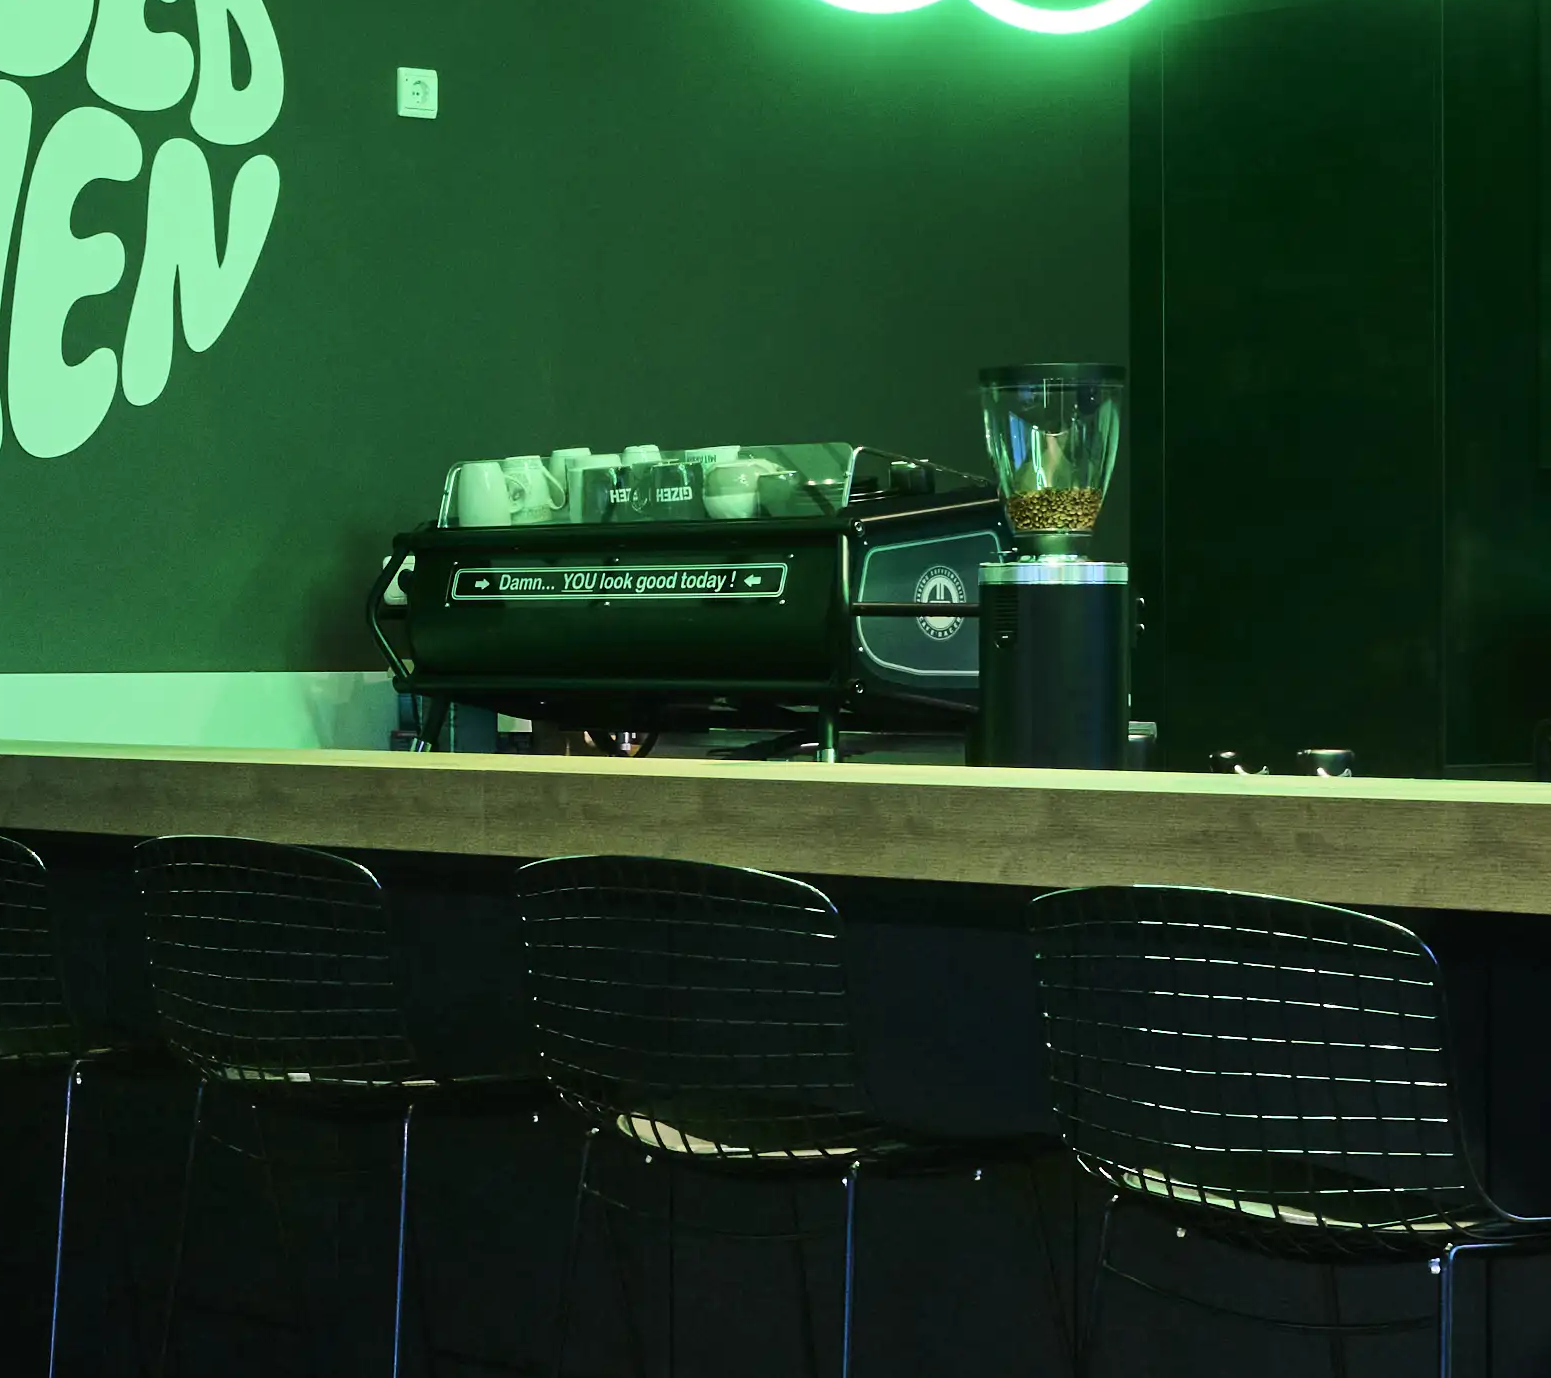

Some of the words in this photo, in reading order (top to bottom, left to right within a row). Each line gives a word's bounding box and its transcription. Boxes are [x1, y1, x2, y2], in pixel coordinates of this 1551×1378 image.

[656, 486, 693, 504] GIZEH
[498, 573, 556, 591] Damn...
[562, 572, 598, 592] YOU
[599, 572, 634, 590] look
[635, 571, 679, 593] good
[680, 571, 727, 593] today
